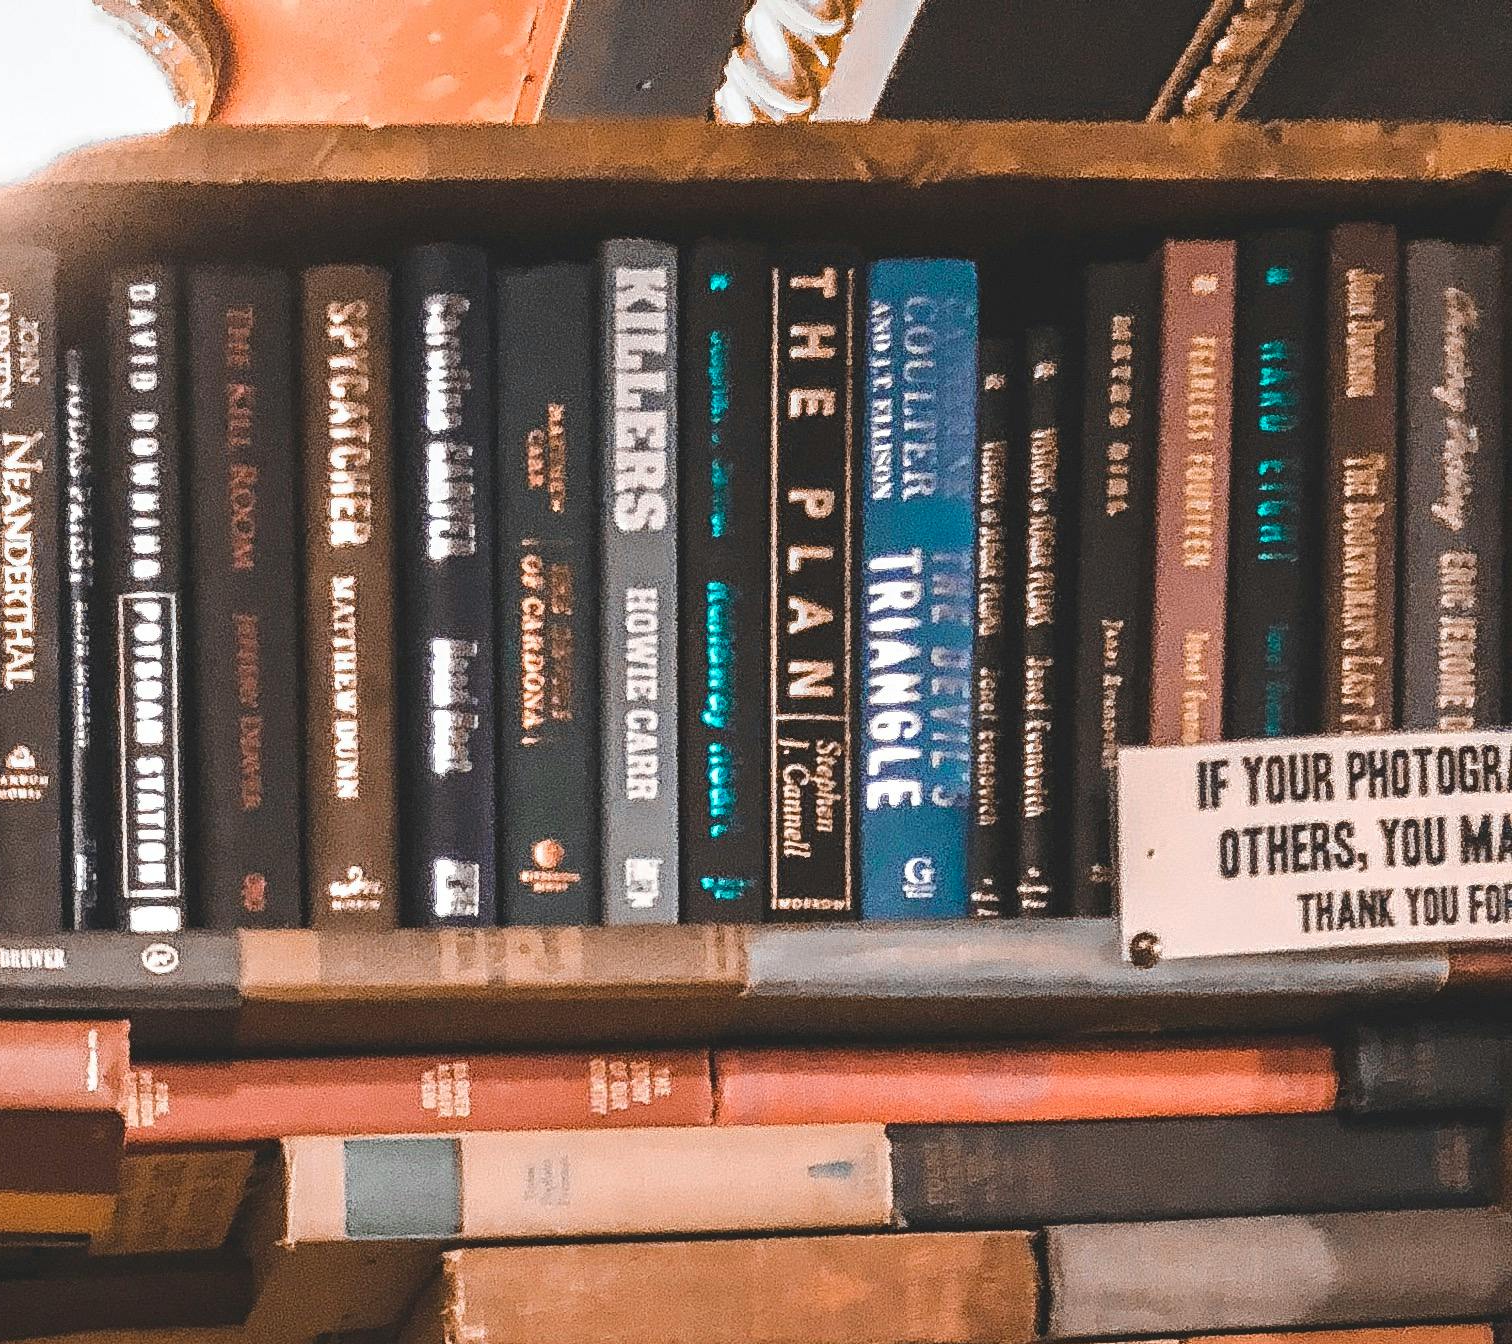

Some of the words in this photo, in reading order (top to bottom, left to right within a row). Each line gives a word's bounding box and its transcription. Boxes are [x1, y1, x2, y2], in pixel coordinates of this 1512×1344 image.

[128, 283, 160, 391] DAVID
[788, 267, 838, 420] THE
[614, 266, 668, 533] KILLERS
[902, 296, 937, 502] COULTER
[129, 412, 161, 580] DOWNING
[0, 432, 45, 690] NEANDERTHAL
[788, 488, 838, 700] PLAN
[131, 601, 165, 745] POTSDAM
[624, 586, 659, 701] HOWIE
[866, 547, 923, 811] TRIANGLE
[625, 709, 660, 801] CARR
[777, 739, 807, 757] J.
[812, 740, 840, 833] Stephen
[1197, 761, 1231, 810] IF
[1242, 754, 1334, 807] YOUR
[1346, 745, 1512, 803] PHOTOGR
[136, 756, 168, 887] STATION
[780, 763, 813, 858] Cannell
[1219, 823, 1367, 881] OTHERS,
[1379, 820, 1449, 869] YOU
[1297, 893, 1394, 934] THANK
[1402, 891, 1460, 928] YOU
